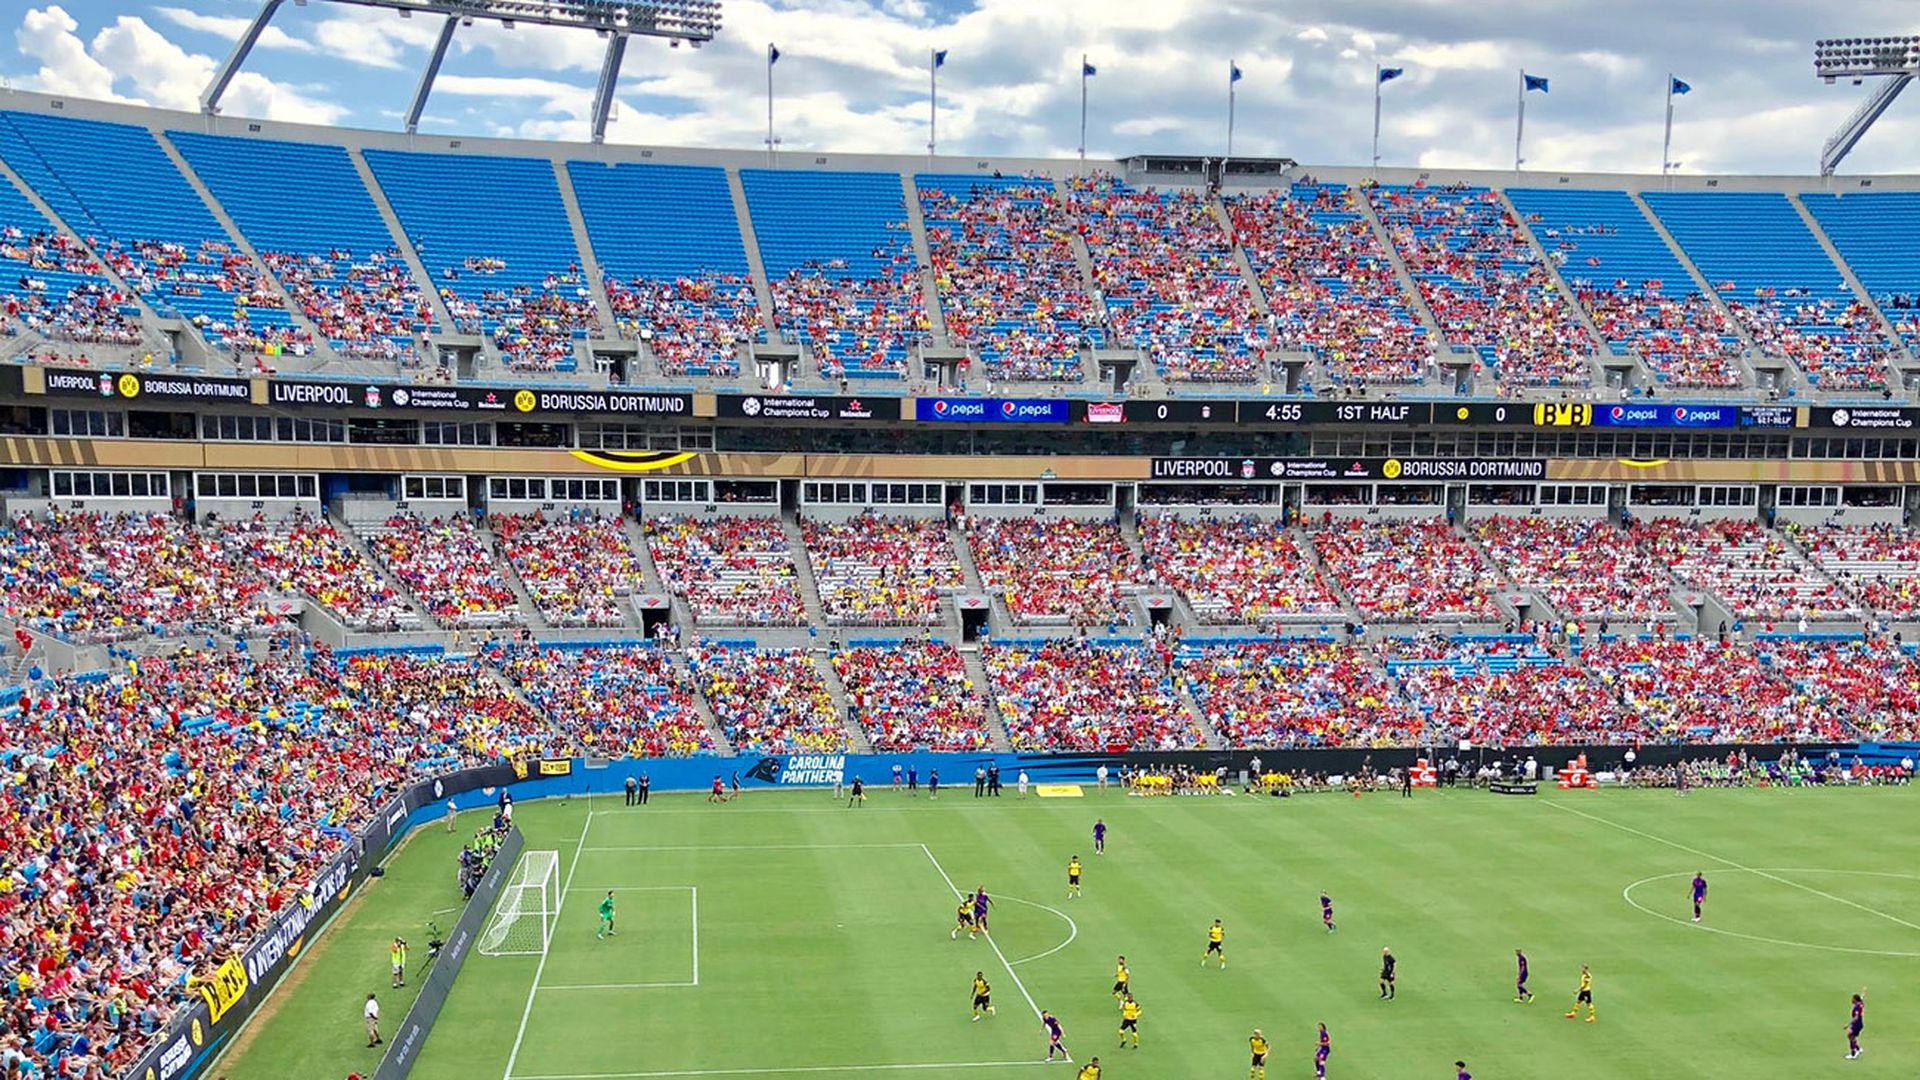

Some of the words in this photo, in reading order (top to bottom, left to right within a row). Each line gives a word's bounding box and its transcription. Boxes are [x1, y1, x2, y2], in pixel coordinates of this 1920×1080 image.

[48, 375, 97, 390] LIVERPOOL
[145, 381, 193, 395] BORUSSIA
[193, 383, 248, 398] DORTMUND
[275, 384, 354, 404] LIVERPOOL
[411, 389, 457, 399] International
[411, 398, 453, 408] Champions
[453, 399, 469, 409] Cup
[541, 394, 607, 410] BORUSSIA
[610, 396, 684, 412] DORTMUND
[763, 398, 815, 407] International
[950, 403, 984, 416] pepsi
[763, 408, 810, 418] Champions
[810, 408, 830, 418] Cup
[1018, 404, 1052, 417] pepsi
[1157, 404, 1168, 419] 0
[1265, 404, 1302, 420] 4:55
[1336, 406, 1364, 420] 1ST
[1371, 406, 1410, 420] HALF
[1495, 407, 1506, 422] 0
[1544, 404, 1584, 425] BVB
[1626, 408, 1658, 421] pepsi
[1689, 409, 1721, 422] pepsi
[1851, 409, 1900, 418] International
[1851, 418, 1894, 428] Champions
[1895, 418, 1912, 428] Cup
[1155, 460, 1233, 476] LIVERPOOL
[1322, 469, 1337, 477] Cup
[1403, 461, 1467, 476] BORUSSIA
[1470, 461, 1542, 476] DORTMUND
[788, 756, 845, 770] CAROLINA
